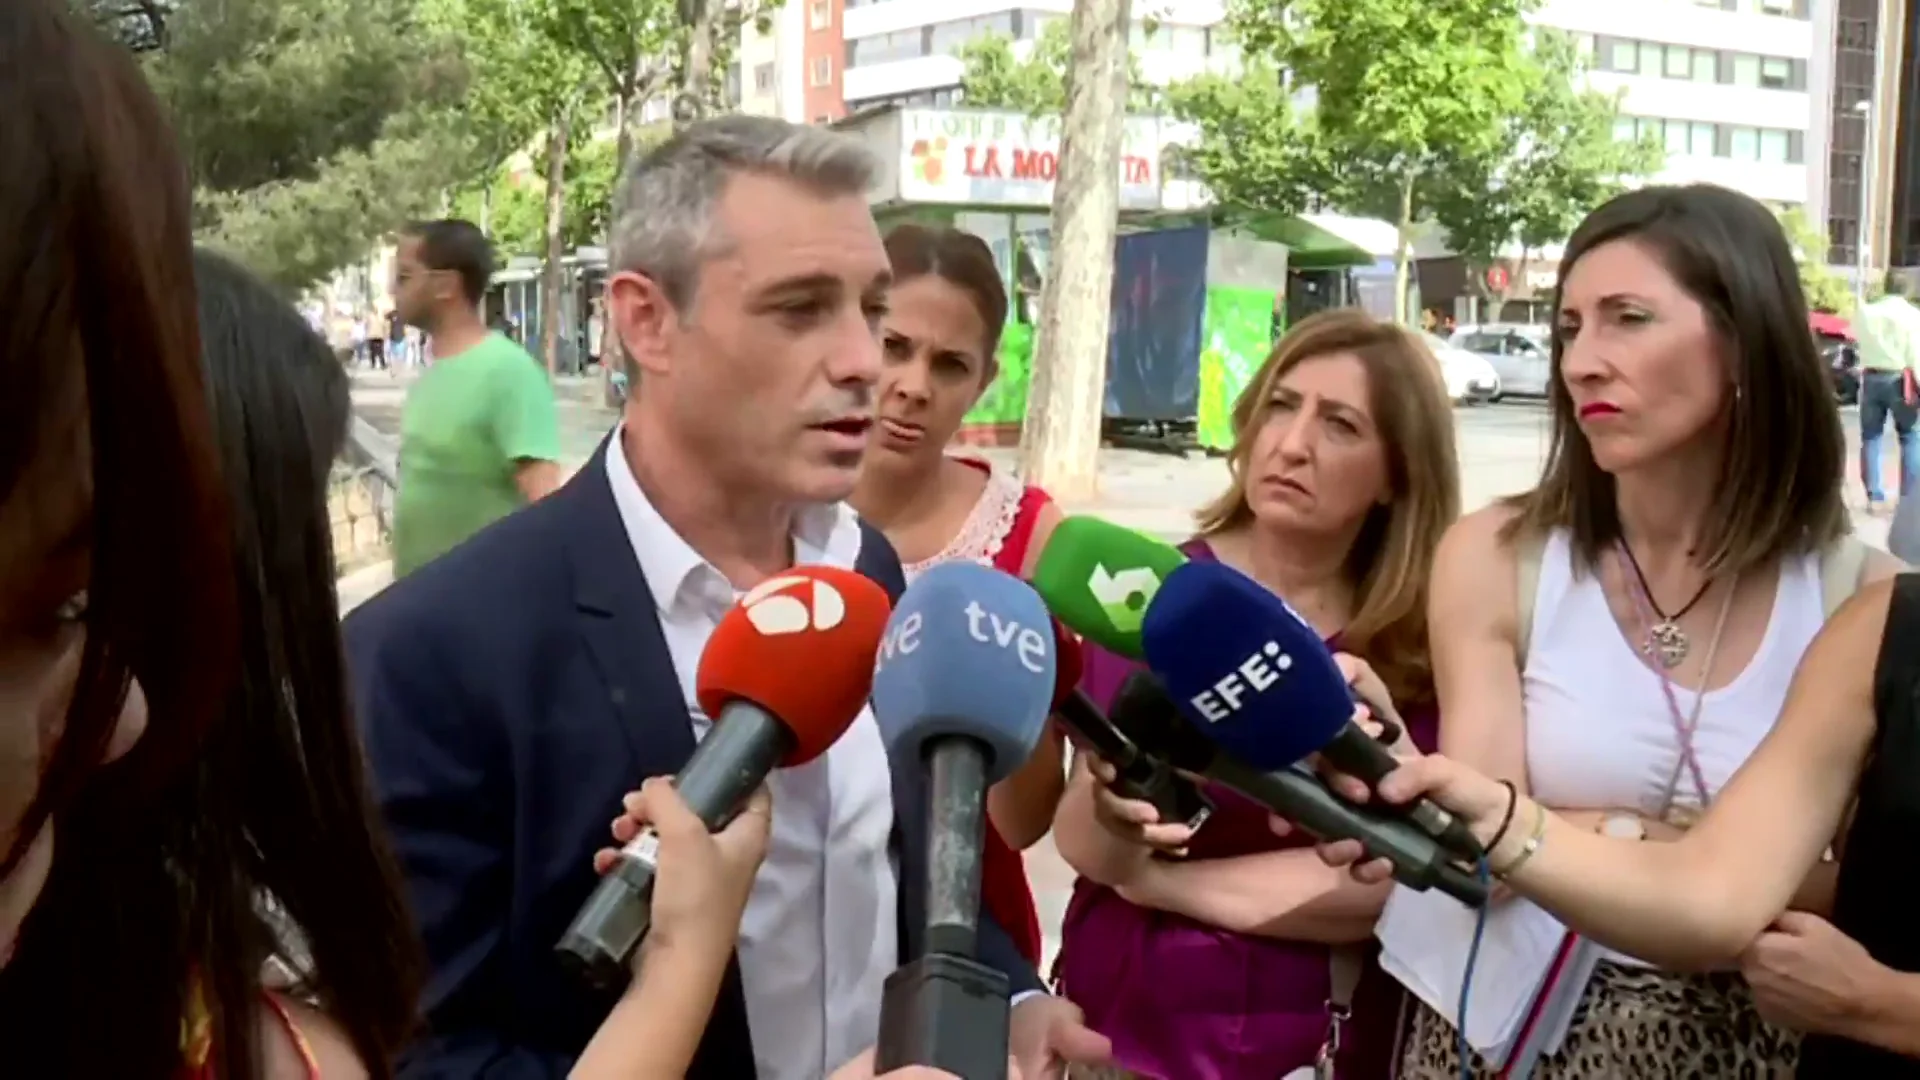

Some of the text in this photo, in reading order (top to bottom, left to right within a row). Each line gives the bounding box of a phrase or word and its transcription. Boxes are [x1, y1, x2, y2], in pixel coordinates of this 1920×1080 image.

[963, 145, 1002, 178] LA
[875, 611, 922, 674] ve
[964, 600, 1046, 673] tve
